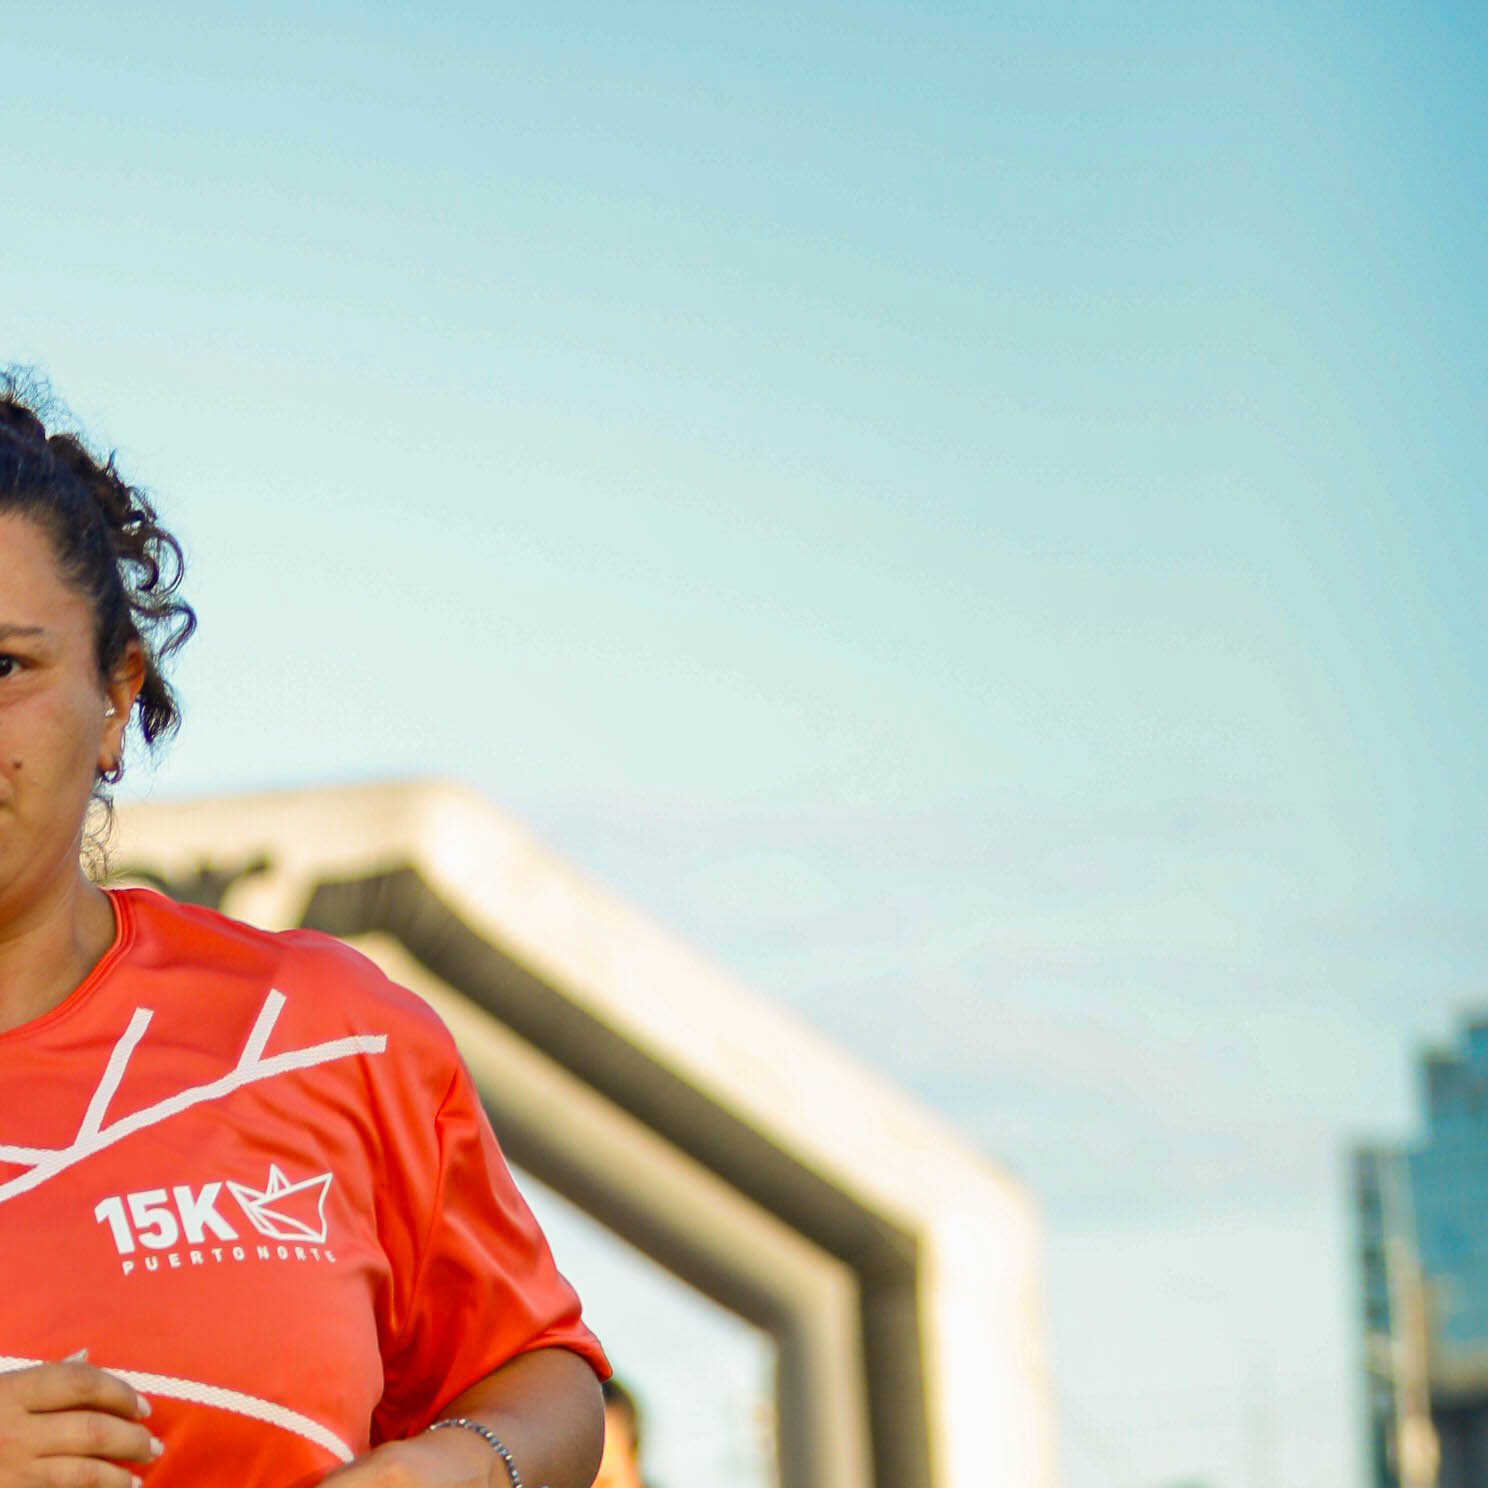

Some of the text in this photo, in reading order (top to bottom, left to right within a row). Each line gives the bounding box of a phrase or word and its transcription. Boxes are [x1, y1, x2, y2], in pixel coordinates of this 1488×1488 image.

[94, 1181, 240, 1255] 15K
[121, 1245, 337, 1276] PUERTO NORTE
